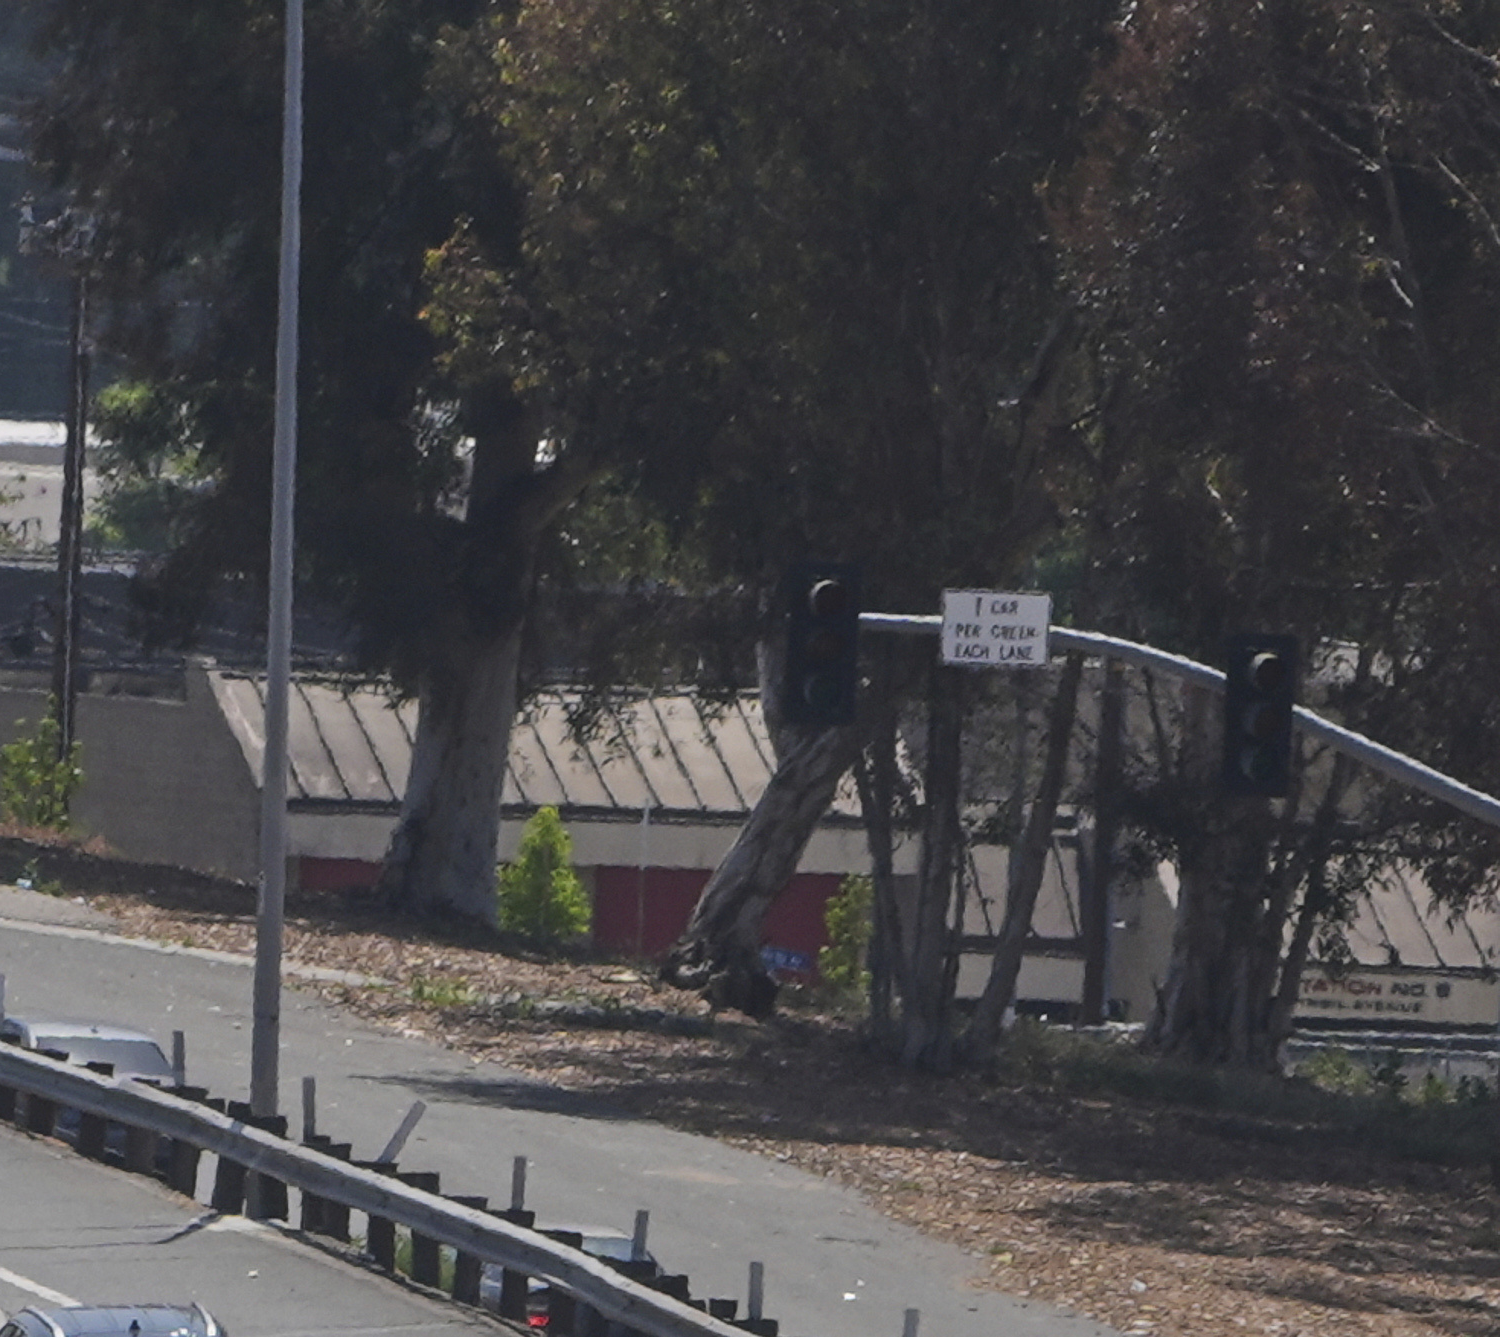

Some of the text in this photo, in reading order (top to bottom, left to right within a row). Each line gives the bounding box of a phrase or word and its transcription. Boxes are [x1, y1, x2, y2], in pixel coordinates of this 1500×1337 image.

[954, 624, 985, 640] PER
[954, 644, 1034, 661] EACH LANE
[1300, 978, 1383, 996] TATION
